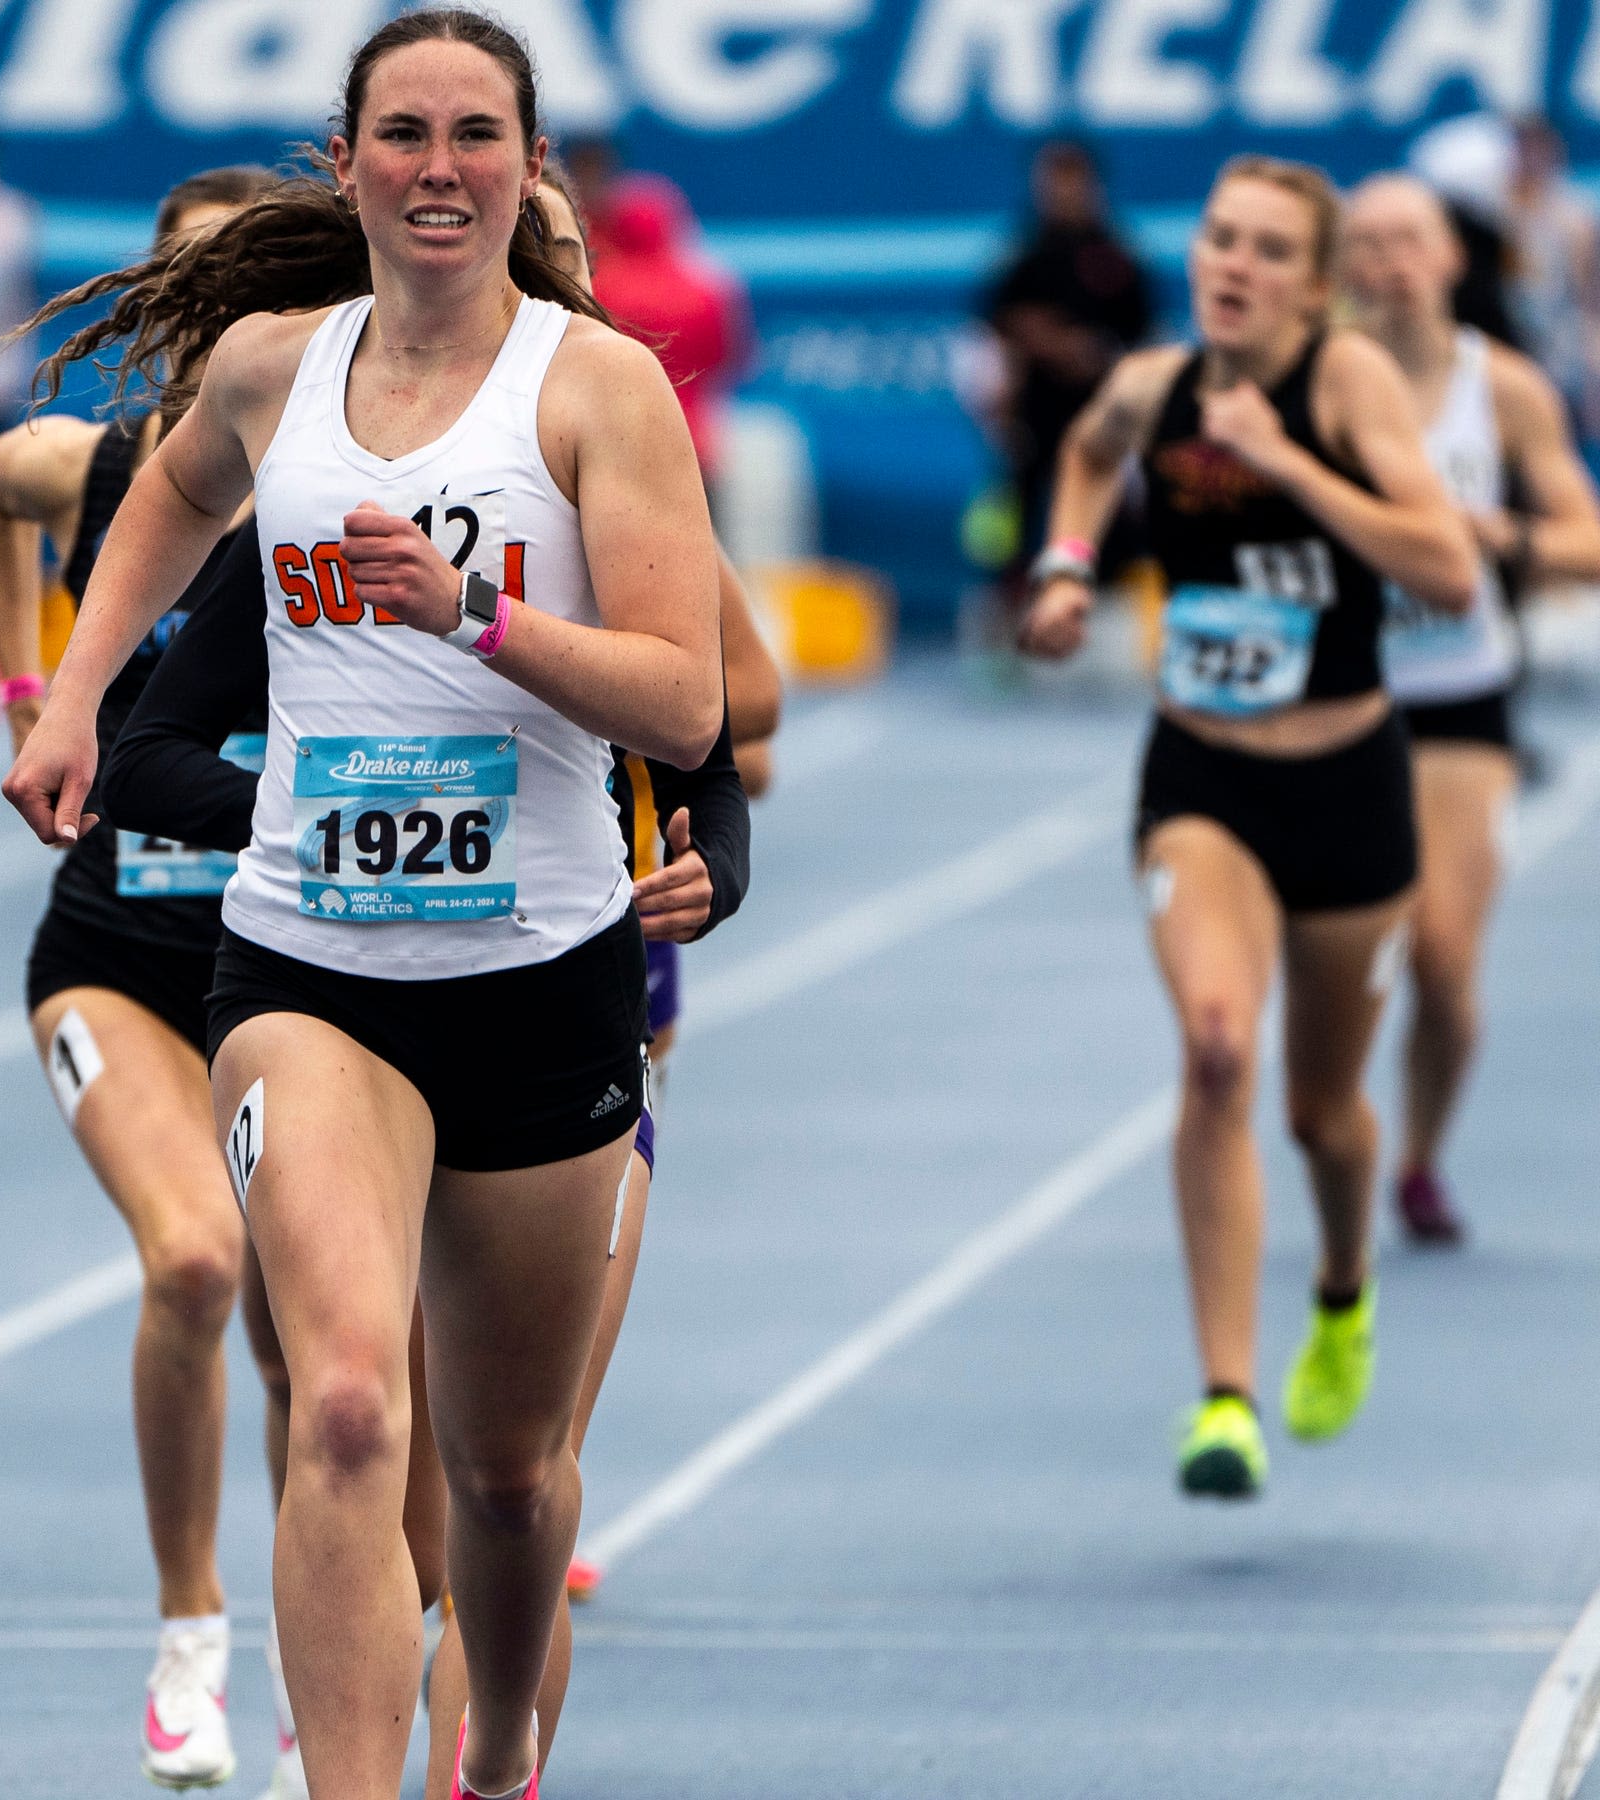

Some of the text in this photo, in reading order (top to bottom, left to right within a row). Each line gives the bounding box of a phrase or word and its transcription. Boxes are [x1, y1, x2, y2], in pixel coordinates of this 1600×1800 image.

[890, 0, 1600, 128] RELA
[398, 744, 426, 753] Annual
[344, 750, 470, 775] Drake RELAYS
[316, 809, 492, 875] 1926
[349, 892, 393, 904] WORLD
[350, 903, 414, 915] ATHLETICS
[424, 897, 495, 909] APRIL 24-27, 2024
[56, 1032, 82, 1089] 1
[590, 1092, 630, 1119] adidas
[233, 1104, 256, 1195] 12
